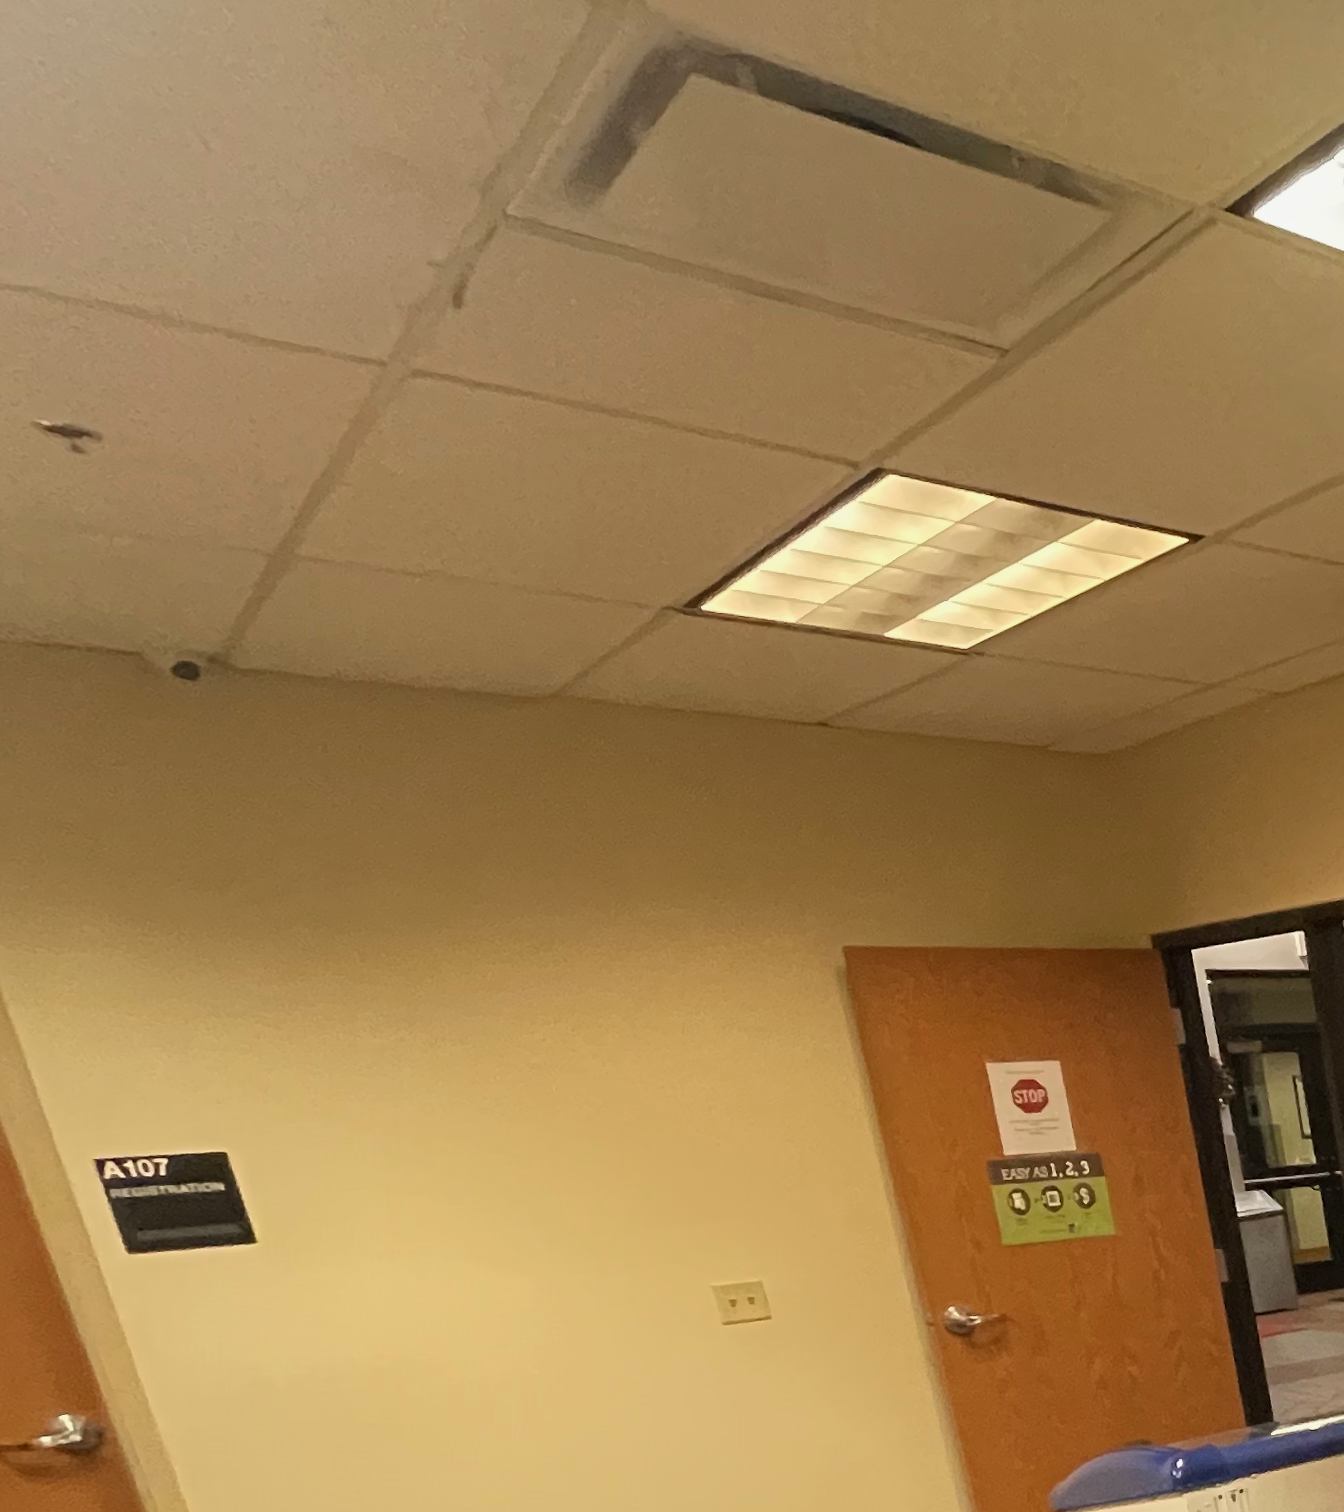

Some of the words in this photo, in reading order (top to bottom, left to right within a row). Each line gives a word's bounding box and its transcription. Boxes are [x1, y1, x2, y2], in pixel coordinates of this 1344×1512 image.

[1013, 1088, 1046, 1104] STOP
[102, 1157, 169, 1180] A107
[1081, 1159, 1090, 1174] 3
